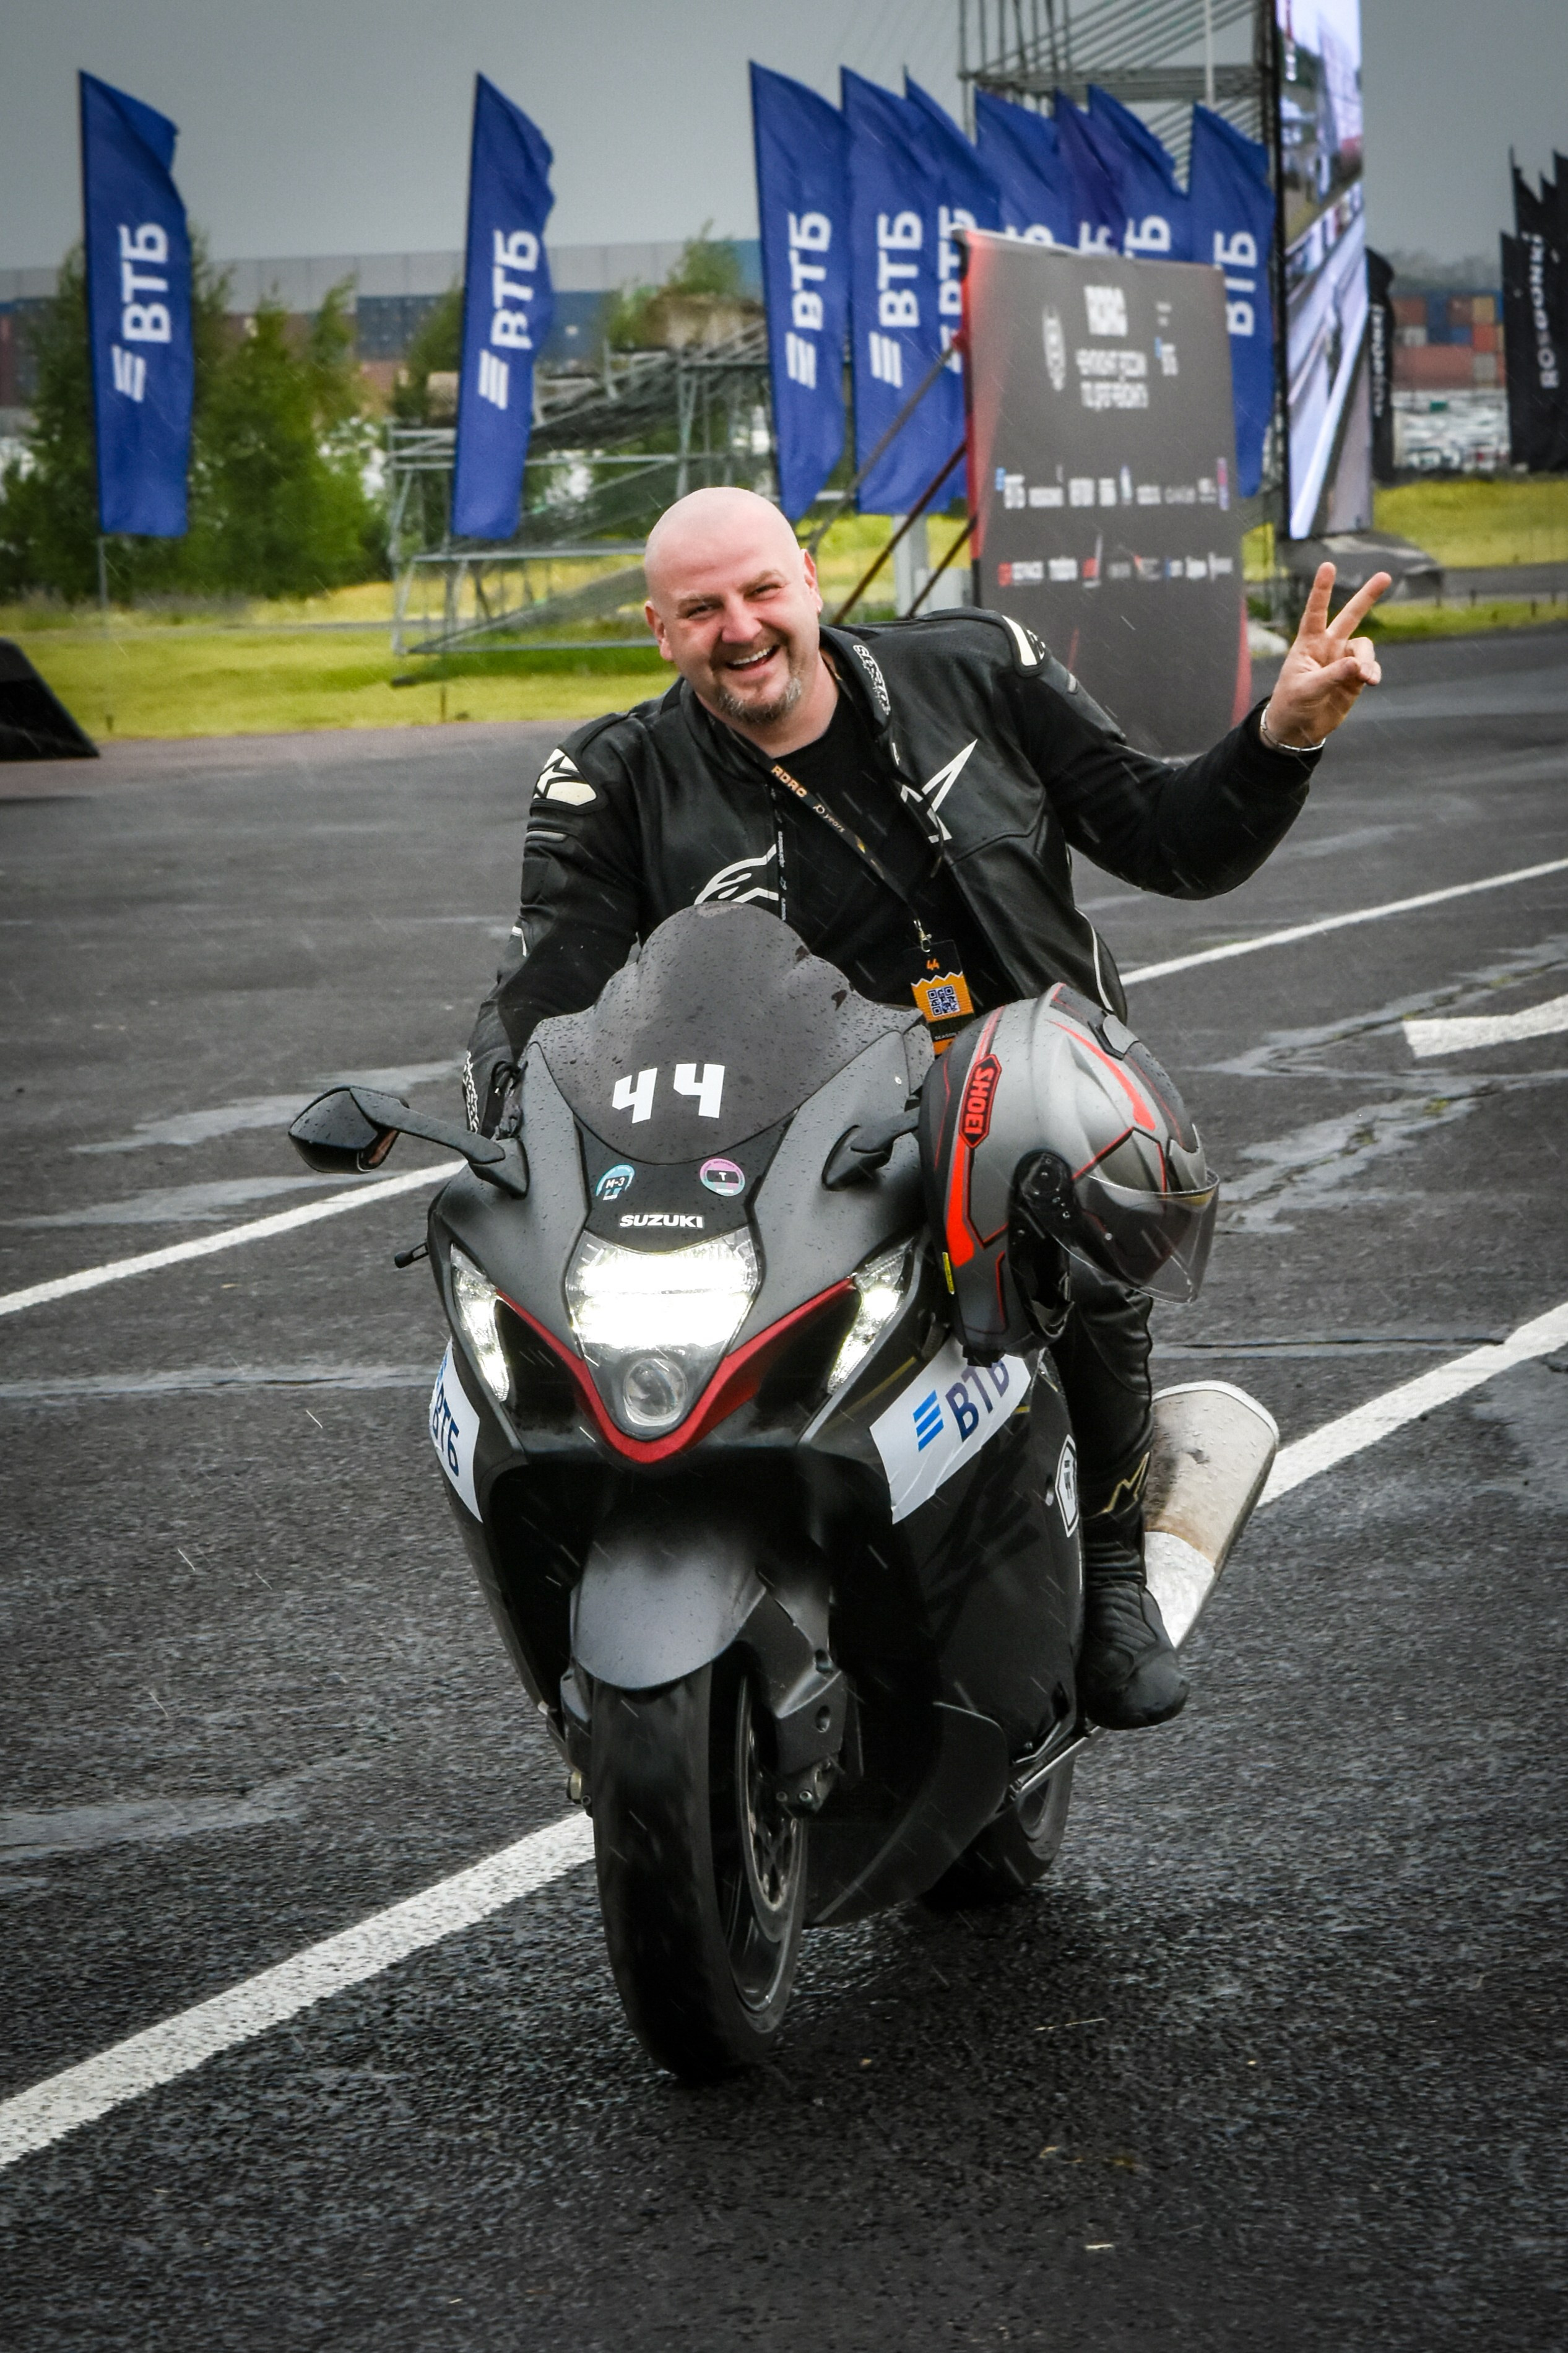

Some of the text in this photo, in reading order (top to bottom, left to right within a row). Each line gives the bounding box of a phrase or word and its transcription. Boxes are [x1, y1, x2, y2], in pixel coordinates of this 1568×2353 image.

[119, 222, 171, 344] ВТБ
[492, 230, 539, 350] ВТБ
[788, 212, 831, 331] ВТБ
[877, 211, 923, 328] ВТБ
[823, 814, 846, 833] years
[926, 959, 940, 970] 44
[612, 1063, 726, 1124] 44
[964, 1066, 995, 1135] SHOEI
[605, 1177, 625, 1189] M-3
[719, 1172, 727, 1181] T
[619, 1214, 704, 1229] SUZUKI
